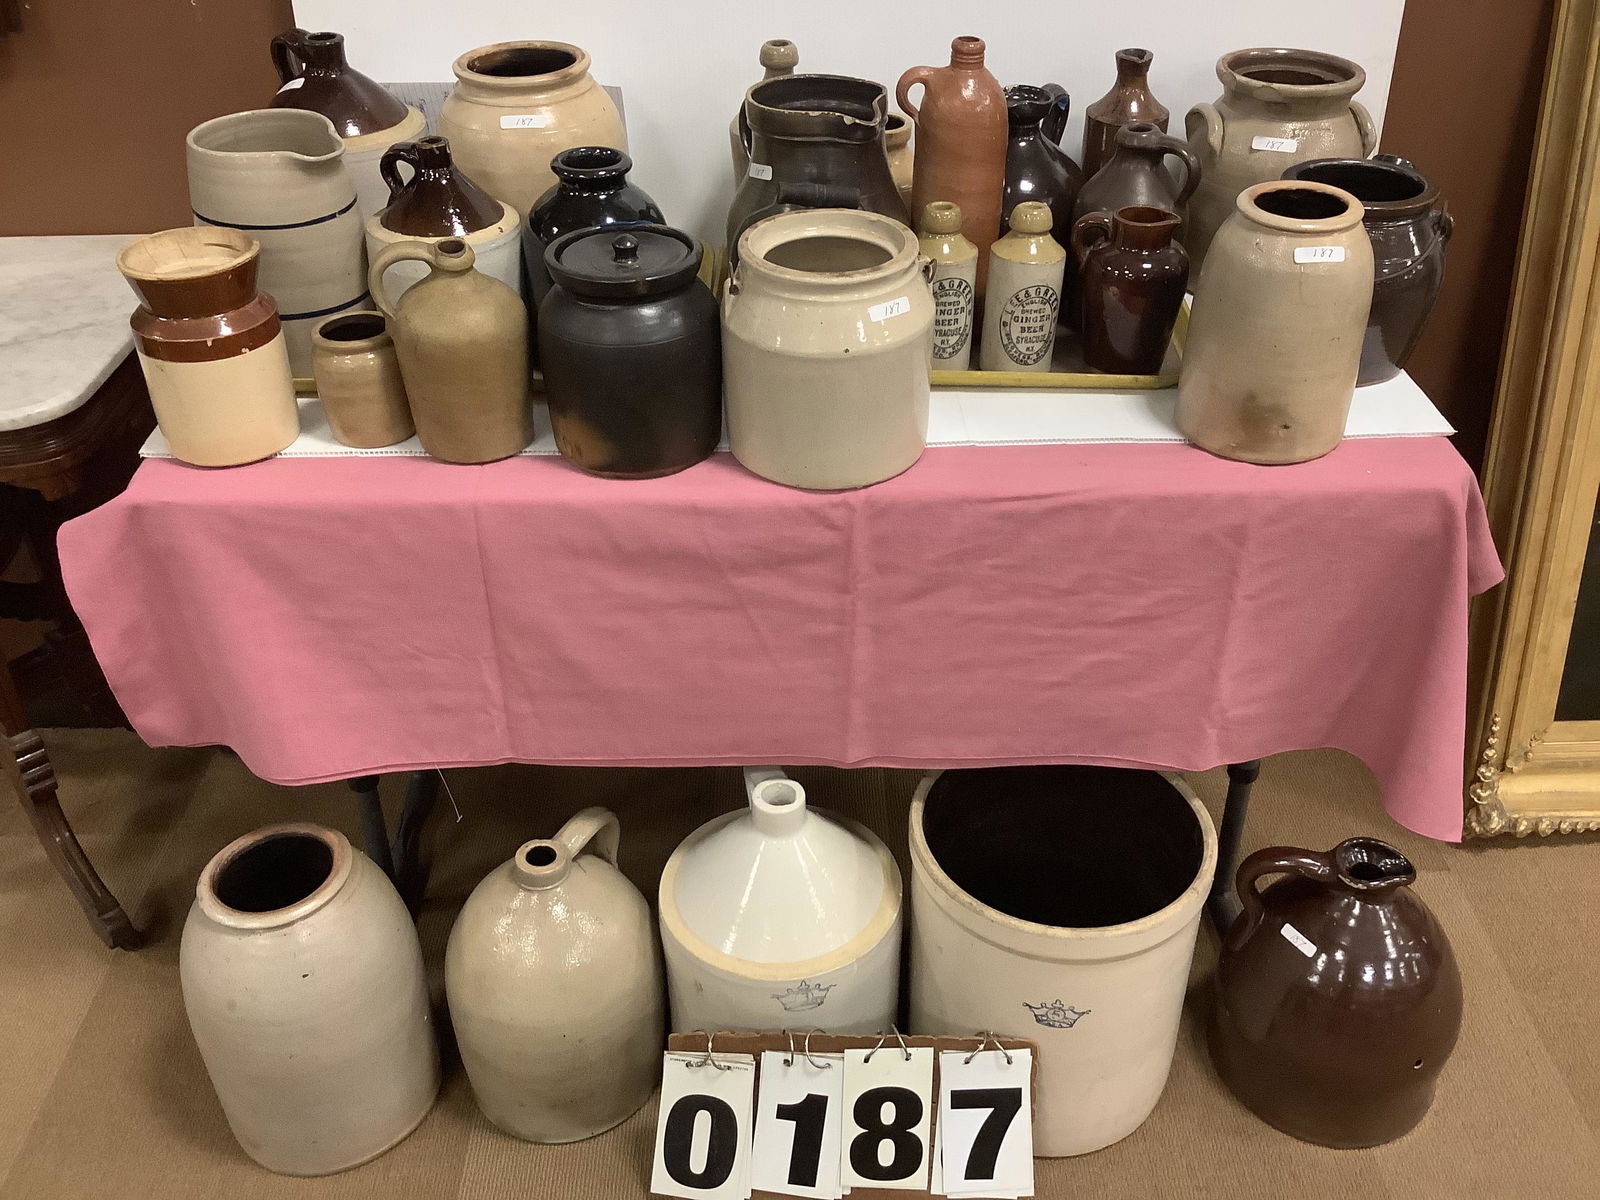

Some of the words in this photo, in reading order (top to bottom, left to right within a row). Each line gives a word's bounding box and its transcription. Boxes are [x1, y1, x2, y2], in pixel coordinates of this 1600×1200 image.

[515, 118, 533, 126] 187
[1265, 140, 1285, 150] 187
[1313, 247, 1333, 258] 187
[885, 302, 900, 316] 187
[935, 306, 965, 316] INGER
[935, 318, 959, 327] BEER
[1013, 314, 1051, 323] GINGER
[934, 326, 962, 337] YRACUSE
[1020, 325, 1044, 334] BEER
